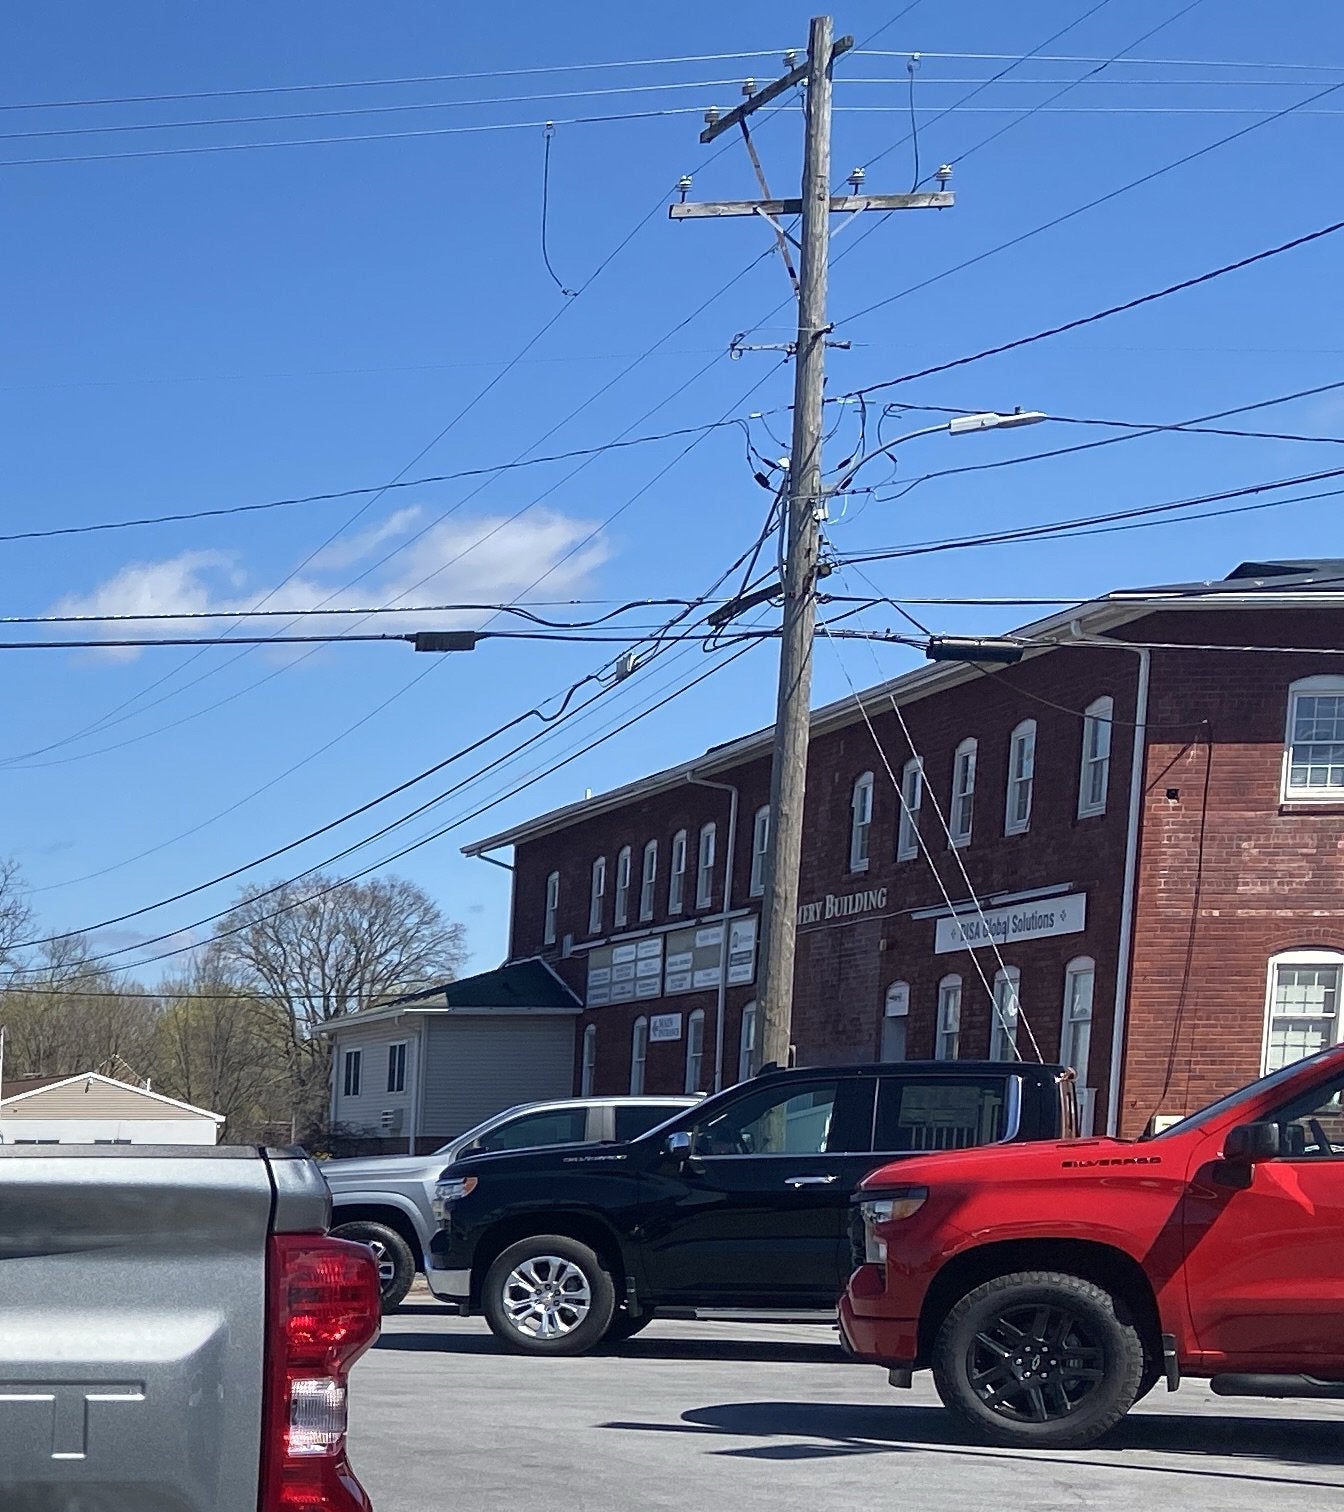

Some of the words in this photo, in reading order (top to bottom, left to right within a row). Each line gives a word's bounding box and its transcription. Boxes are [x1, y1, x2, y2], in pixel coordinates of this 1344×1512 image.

[982, 916, 1010, 940] Global
[1011, 910, 1056, 934] Solutions
[1061, 1156, 1162, 1168] SILVERADO
